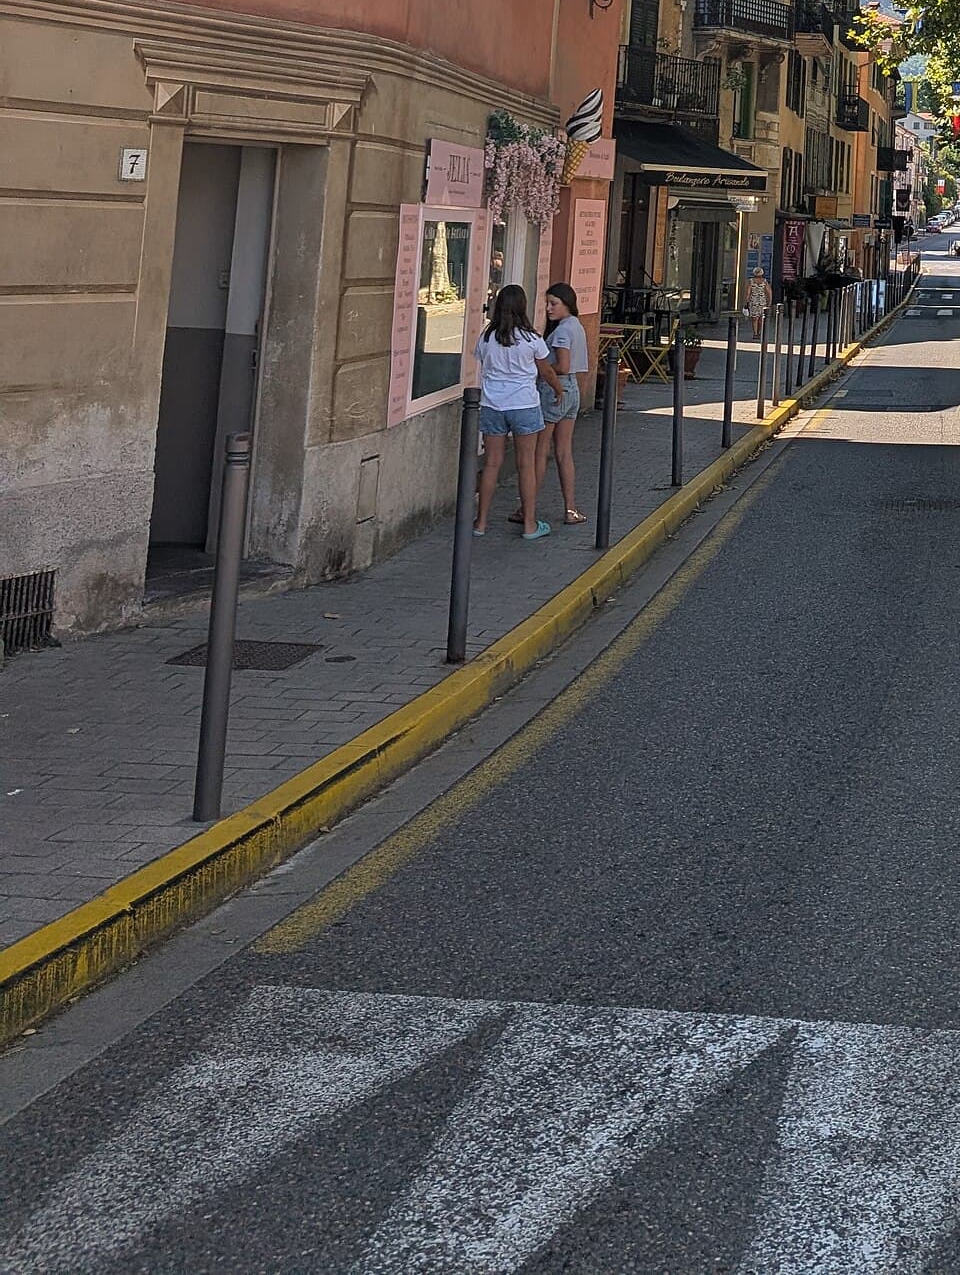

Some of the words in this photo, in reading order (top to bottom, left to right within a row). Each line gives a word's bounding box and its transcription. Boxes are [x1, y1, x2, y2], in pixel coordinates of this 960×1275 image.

[128, 154, 141, 175] 7
[665, 172, 711, 187] Boulangerie
[712, 174, 750, 188] Artisanale
